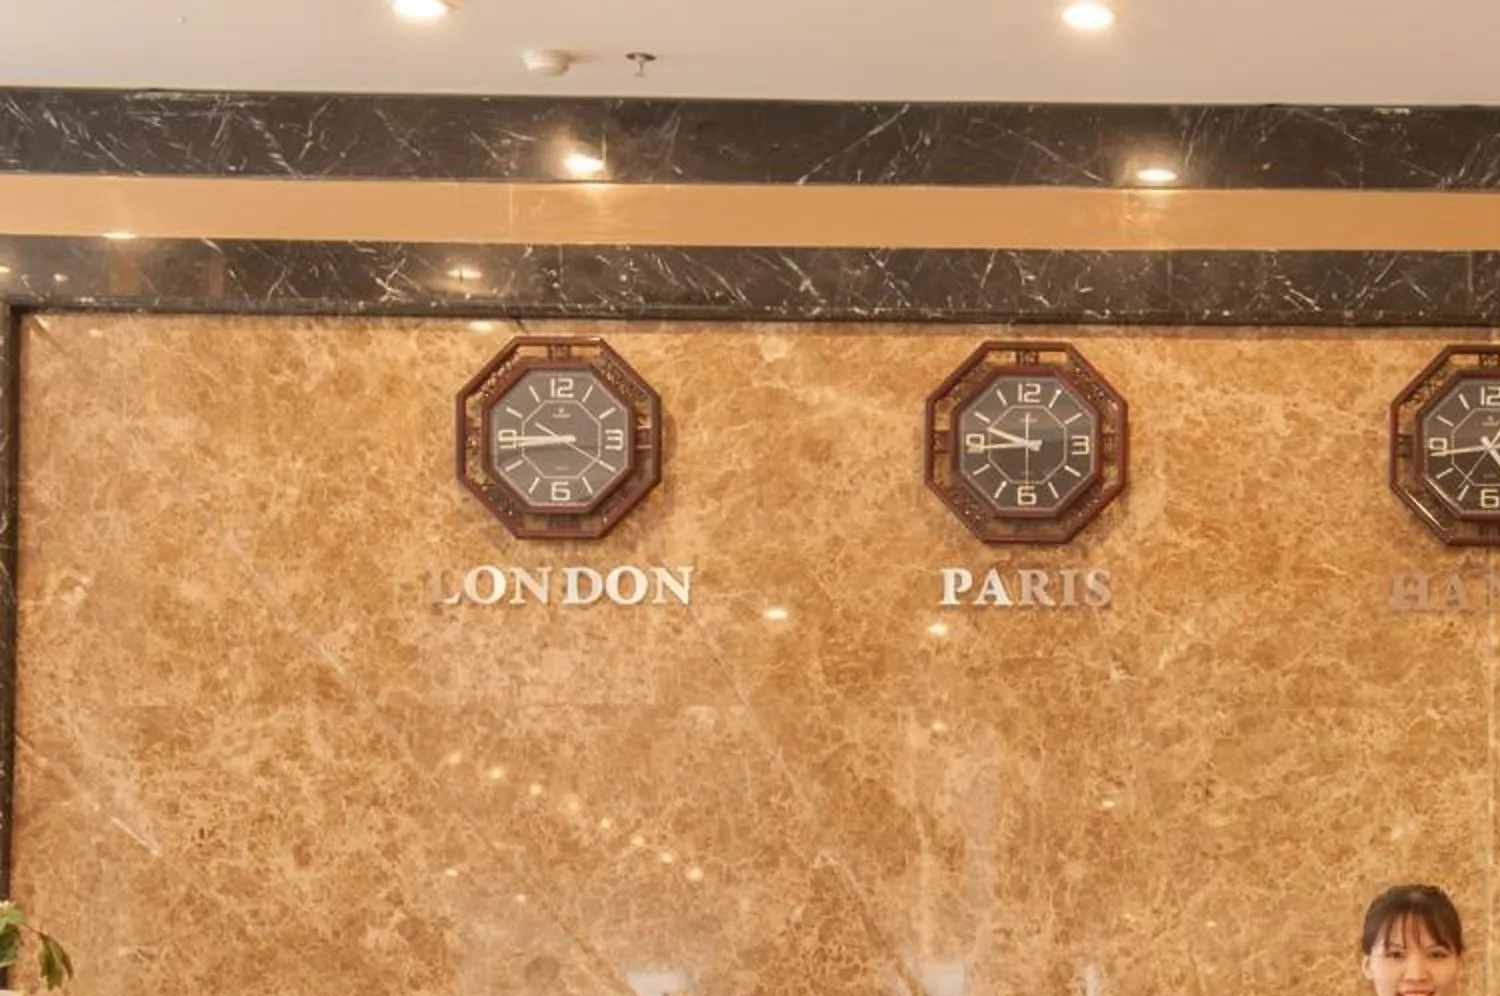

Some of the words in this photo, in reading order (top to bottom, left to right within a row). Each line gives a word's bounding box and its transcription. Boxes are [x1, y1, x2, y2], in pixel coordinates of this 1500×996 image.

[549, 377, 575, 399] 12
[1017, 383, 1042, 403] 12
[604, 428, 624, 452] 3
[1071, 435, 1090, 455] 3
[1429, 437, 1448, 457] 9
[550, 481, 571, 501] 6
[1017, 485, 1037, 506] 6
[1480, 489, 1500, 509] 6
[431, 564, 694, 605] LONDON
[939, 566, 1113, 607] PARIS
